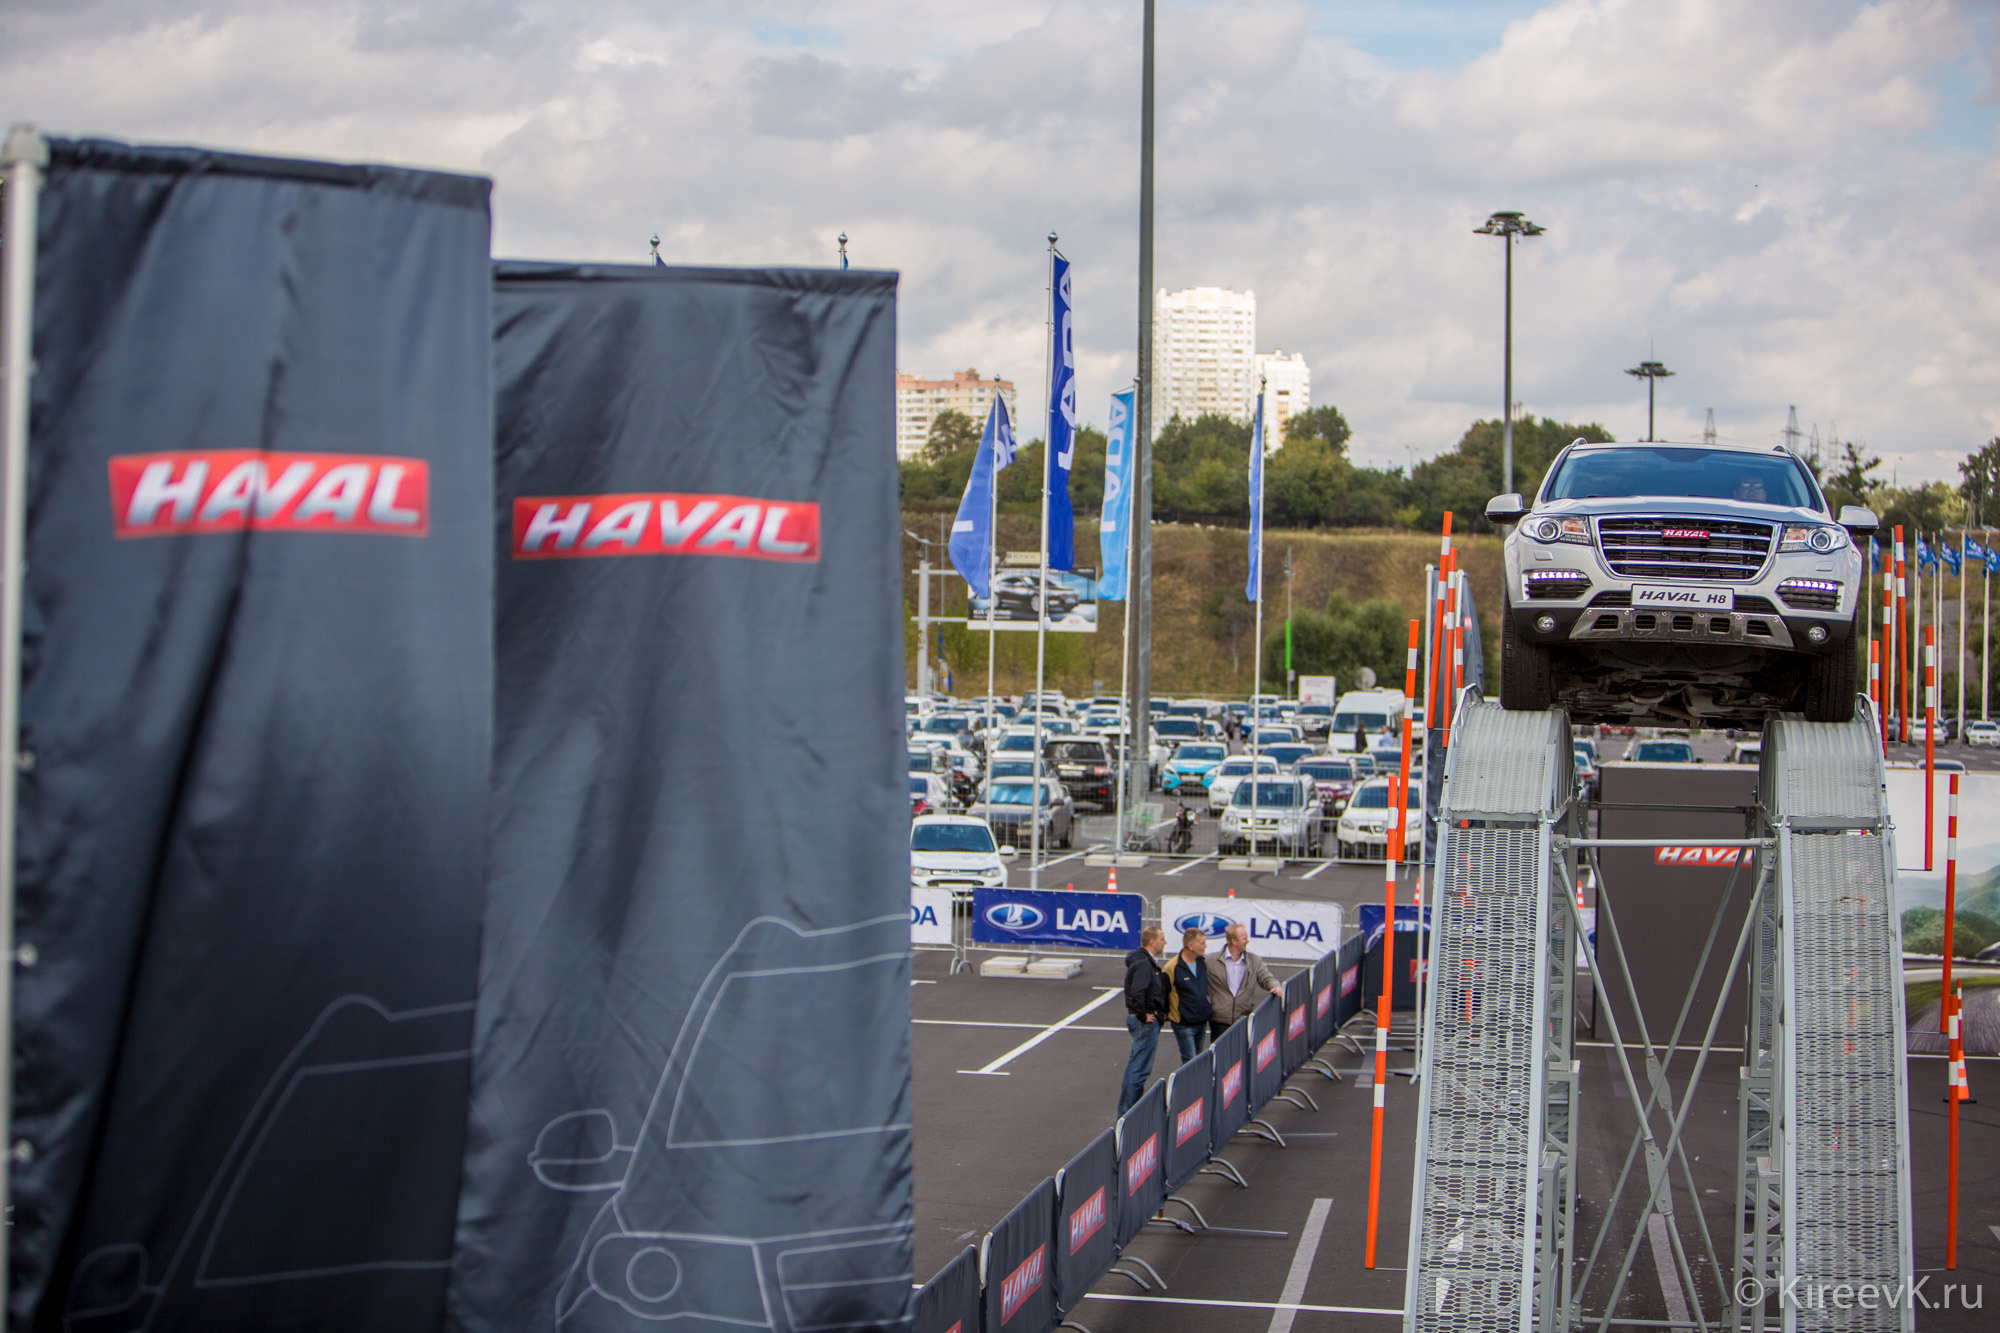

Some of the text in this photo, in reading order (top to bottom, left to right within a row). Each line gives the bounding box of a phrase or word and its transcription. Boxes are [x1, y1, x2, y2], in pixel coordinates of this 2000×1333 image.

[126, 459, 420, 525] HAVAL
[521, 500, 809, 555] HAVAL
[1665, 529, 1707, 538] HAVAL
[1639, 590, 1727, 604] HAVAL H8
[1056, 907, 1129, 933] LADA
[1250, 917, 1323, 942] LADA
[1129, 1139, 1157, 1190] HAVAL
[1071, 1192, 1105, 1250] HAVAL
[1002, 1250, 1042, 1320] HAVAL
